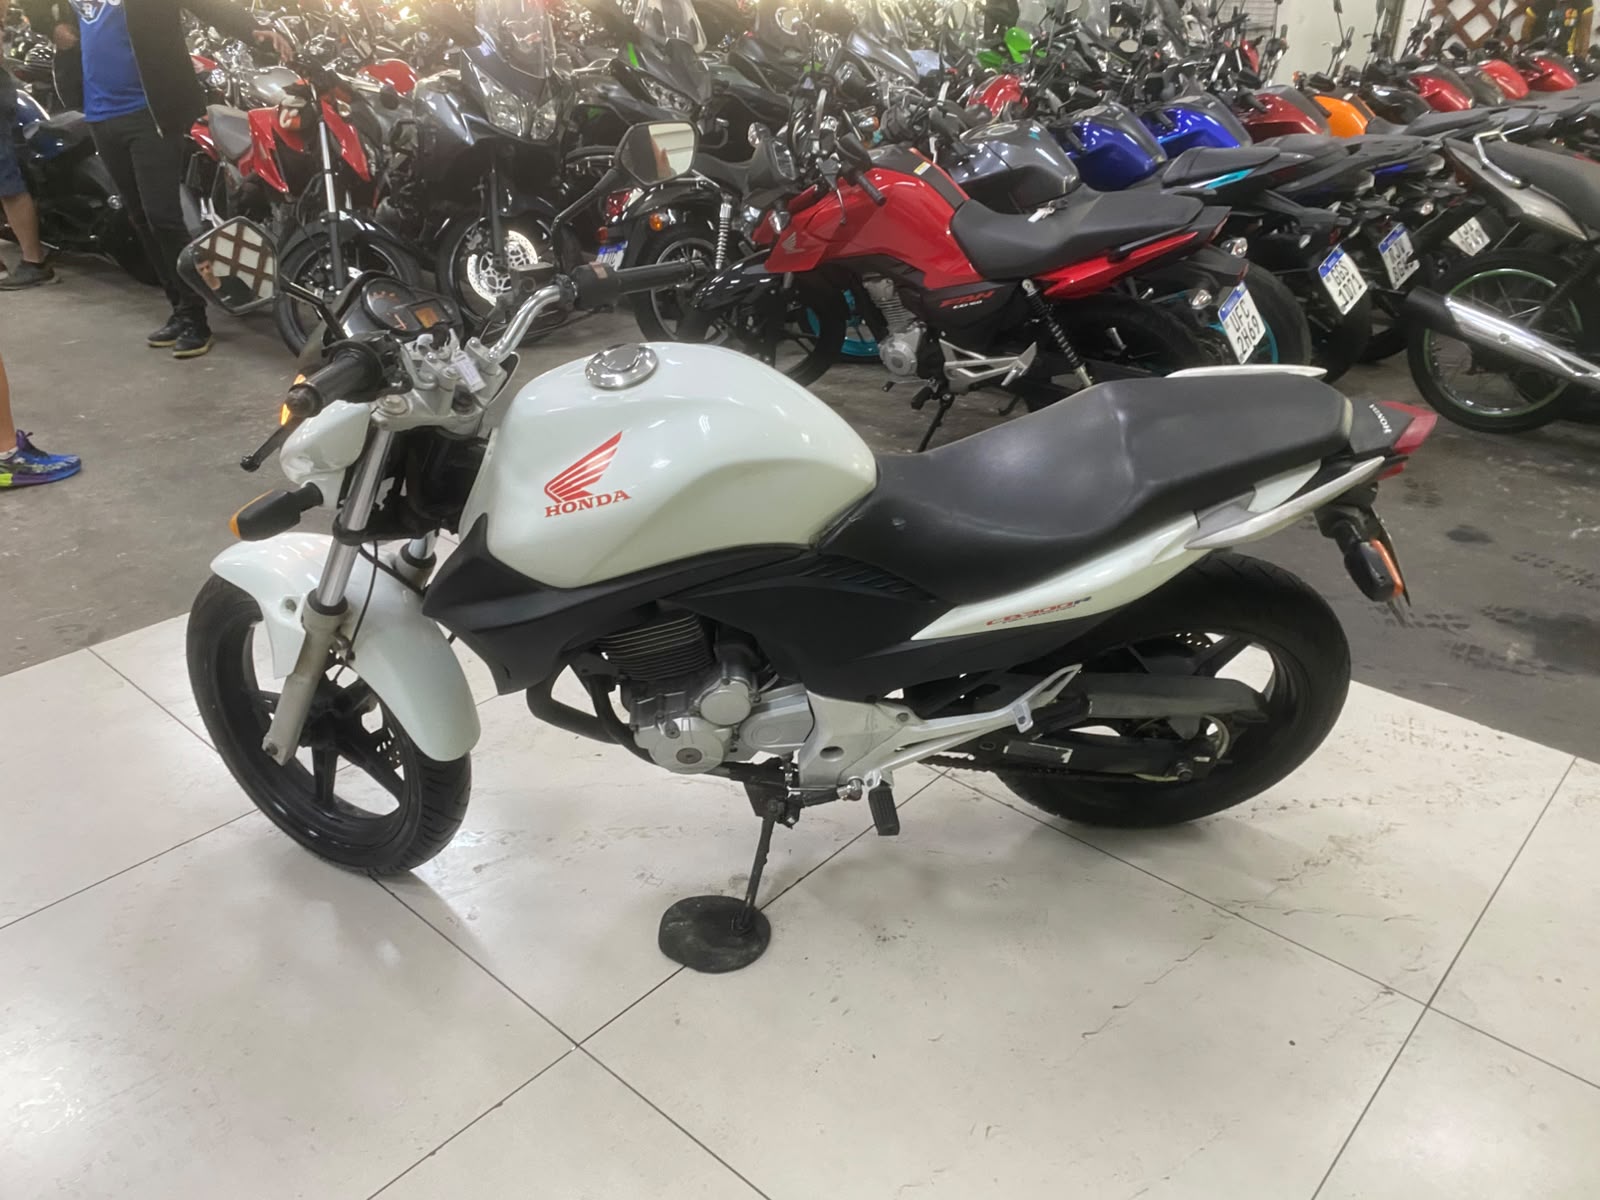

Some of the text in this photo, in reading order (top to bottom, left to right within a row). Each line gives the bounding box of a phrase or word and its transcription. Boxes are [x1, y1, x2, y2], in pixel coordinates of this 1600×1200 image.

[1338, 273, 1362, 307] 1D71
[1229, 299, 1250, 333] UFC
[1237, 315, 1260, 354] 2H69
[544, 489, 632, 518] HONDA
[986, 596, 1092, 626] CB300R
